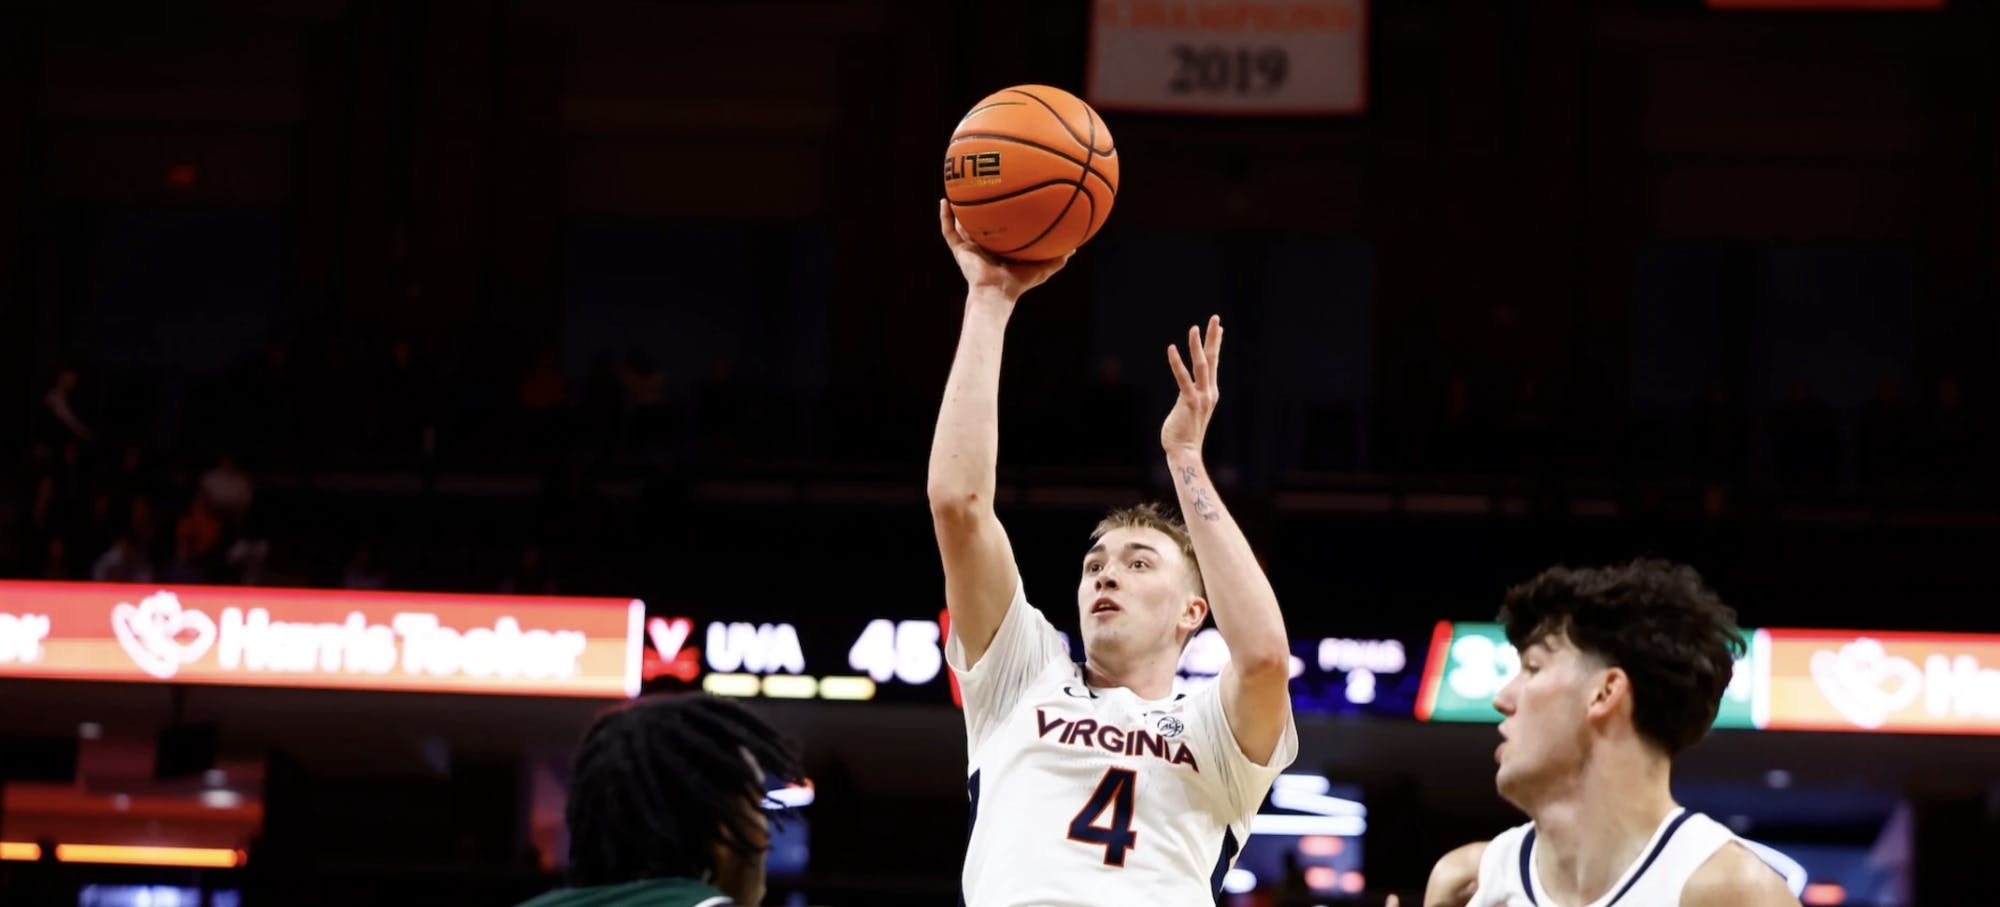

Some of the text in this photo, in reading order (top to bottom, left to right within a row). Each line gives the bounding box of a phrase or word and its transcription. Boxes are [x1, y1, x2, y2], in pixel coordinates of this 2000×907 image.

[1167, 43, 1288, 93] 2019
[706, 621, 805, 674] UVA
[848, 618, 942, 684] 45
[1035, 707, 1200, 773] VIRGINIA
[1066, 764, 1137, 868] 4
